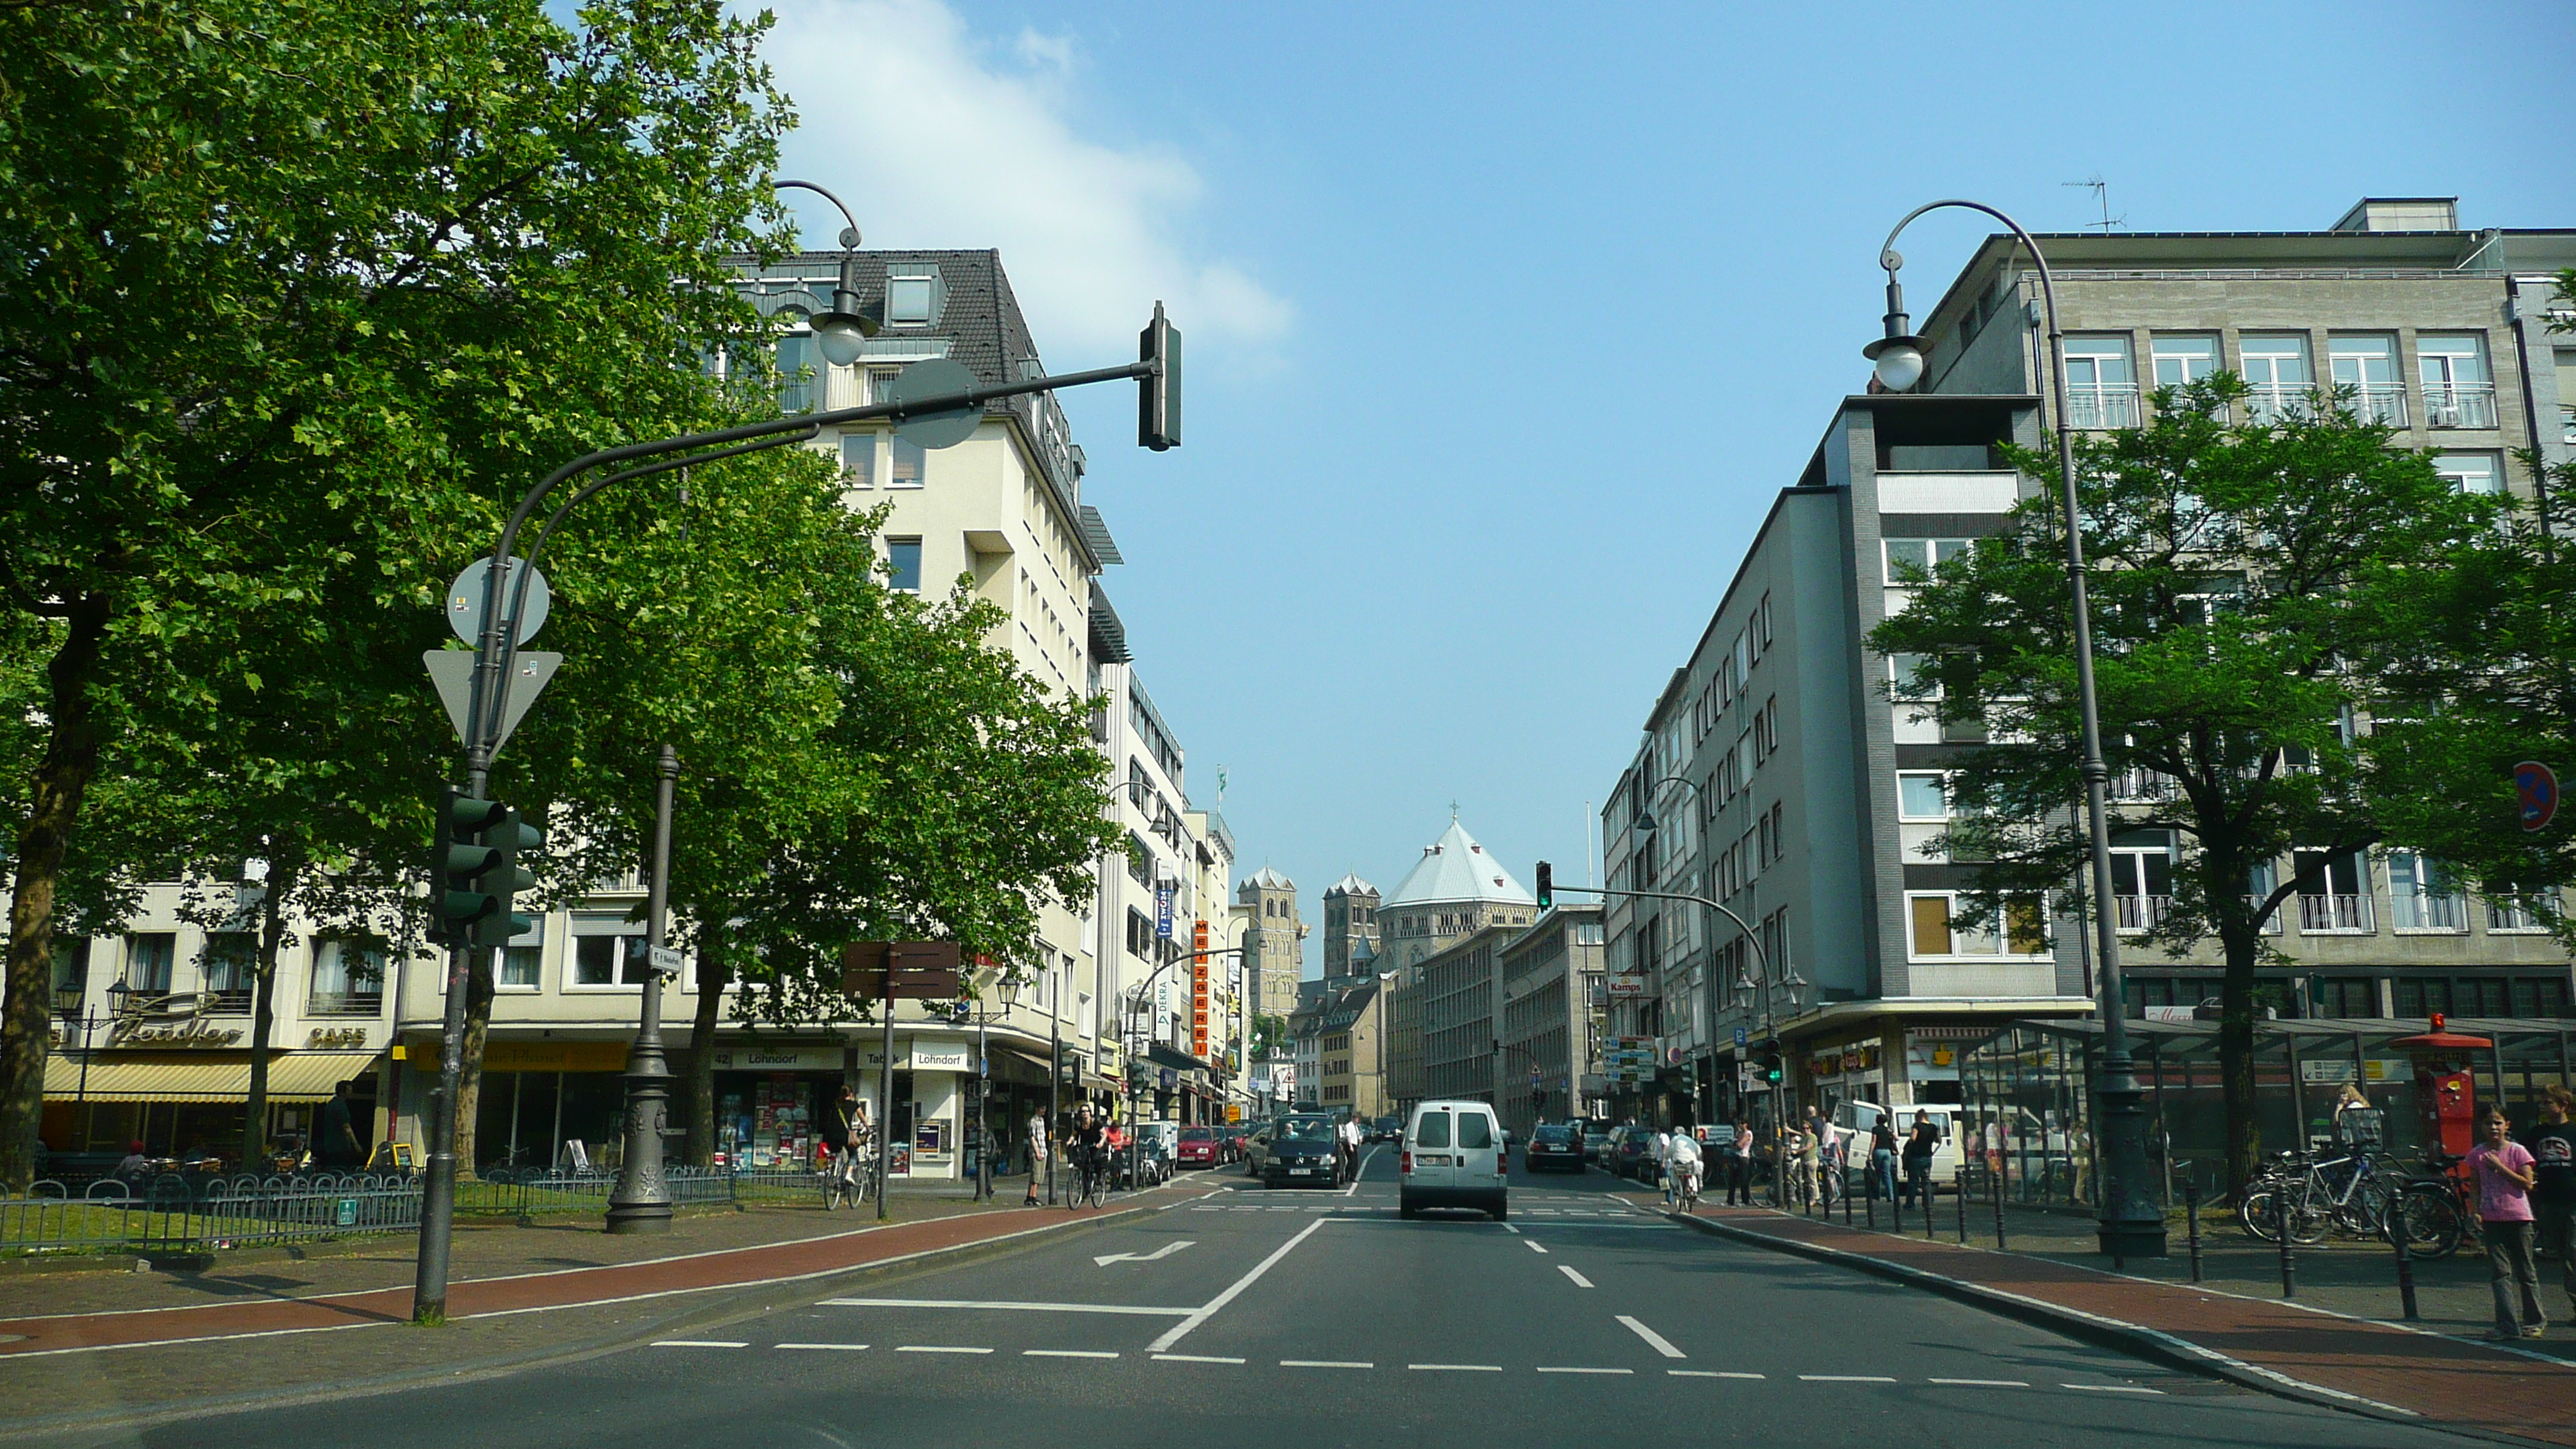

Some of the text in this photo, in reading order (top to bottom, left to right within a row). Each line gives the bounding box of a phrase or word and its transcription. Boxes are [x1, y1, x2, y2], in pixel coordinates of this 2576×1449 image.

[1611, 982, 1641, 992] Kamps
[1158, 981, 1167, 1012] DEKRA
[310, 1027, 367, 1043] CAFE
[714, 1053, 729, 1064] 42
[748, 1053, 797, 1064] Löhndorf
[867, 1053, 899, 1064] Tabk
[919, 1053, 961, 1065] Löhndorf
